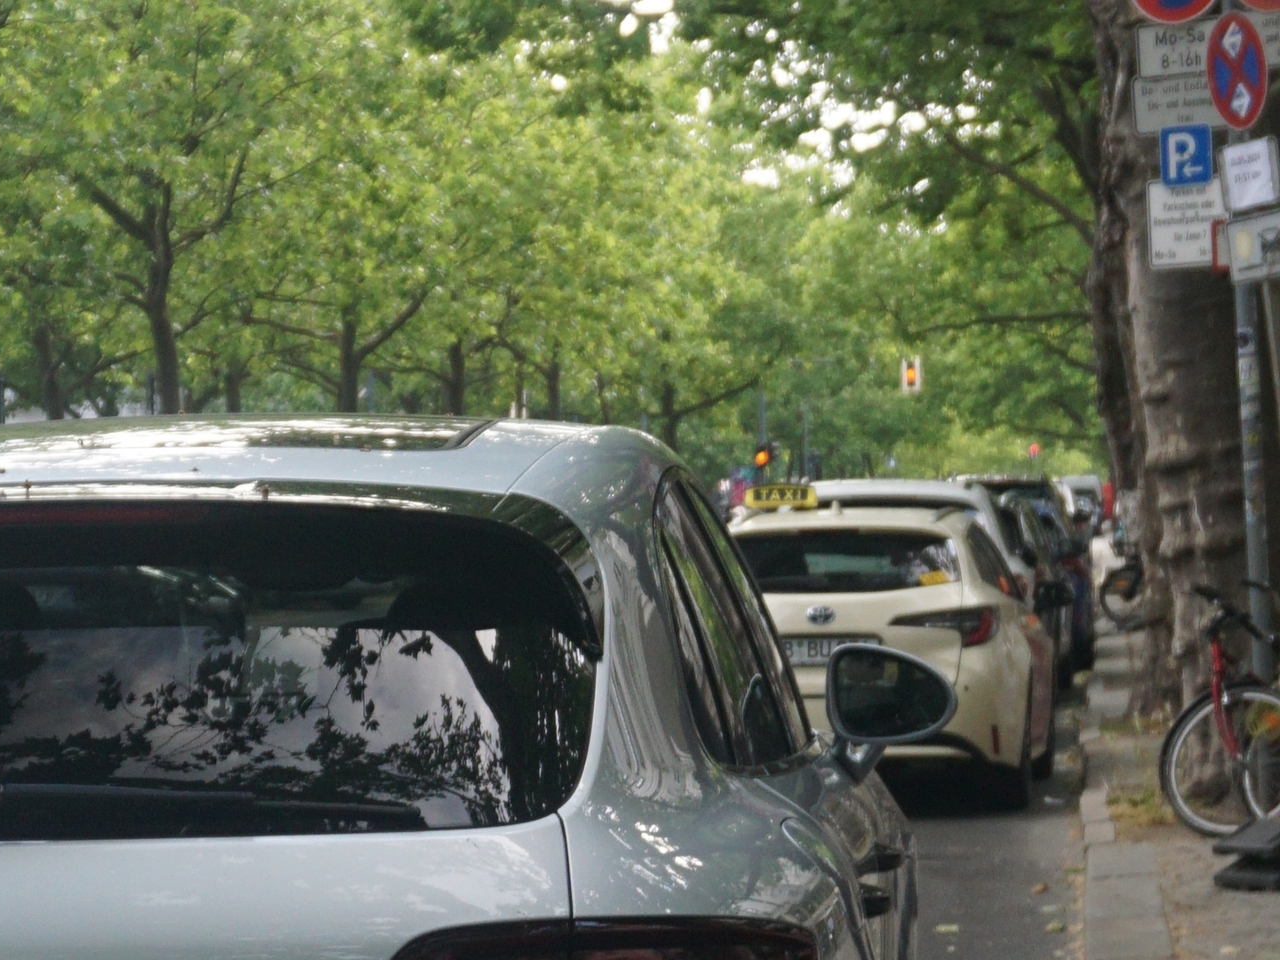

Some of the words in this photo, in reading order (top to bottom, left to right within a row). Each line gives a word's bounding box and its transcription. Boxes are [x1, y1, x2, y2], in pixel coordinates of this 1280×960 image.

[1155, 27, 1206, 47] Mo-Sa
[1161, 50, 1202, 69] 8-16h
[1167, 132, 1196, 179] P
[760, 489, 803, 501] TAXI
